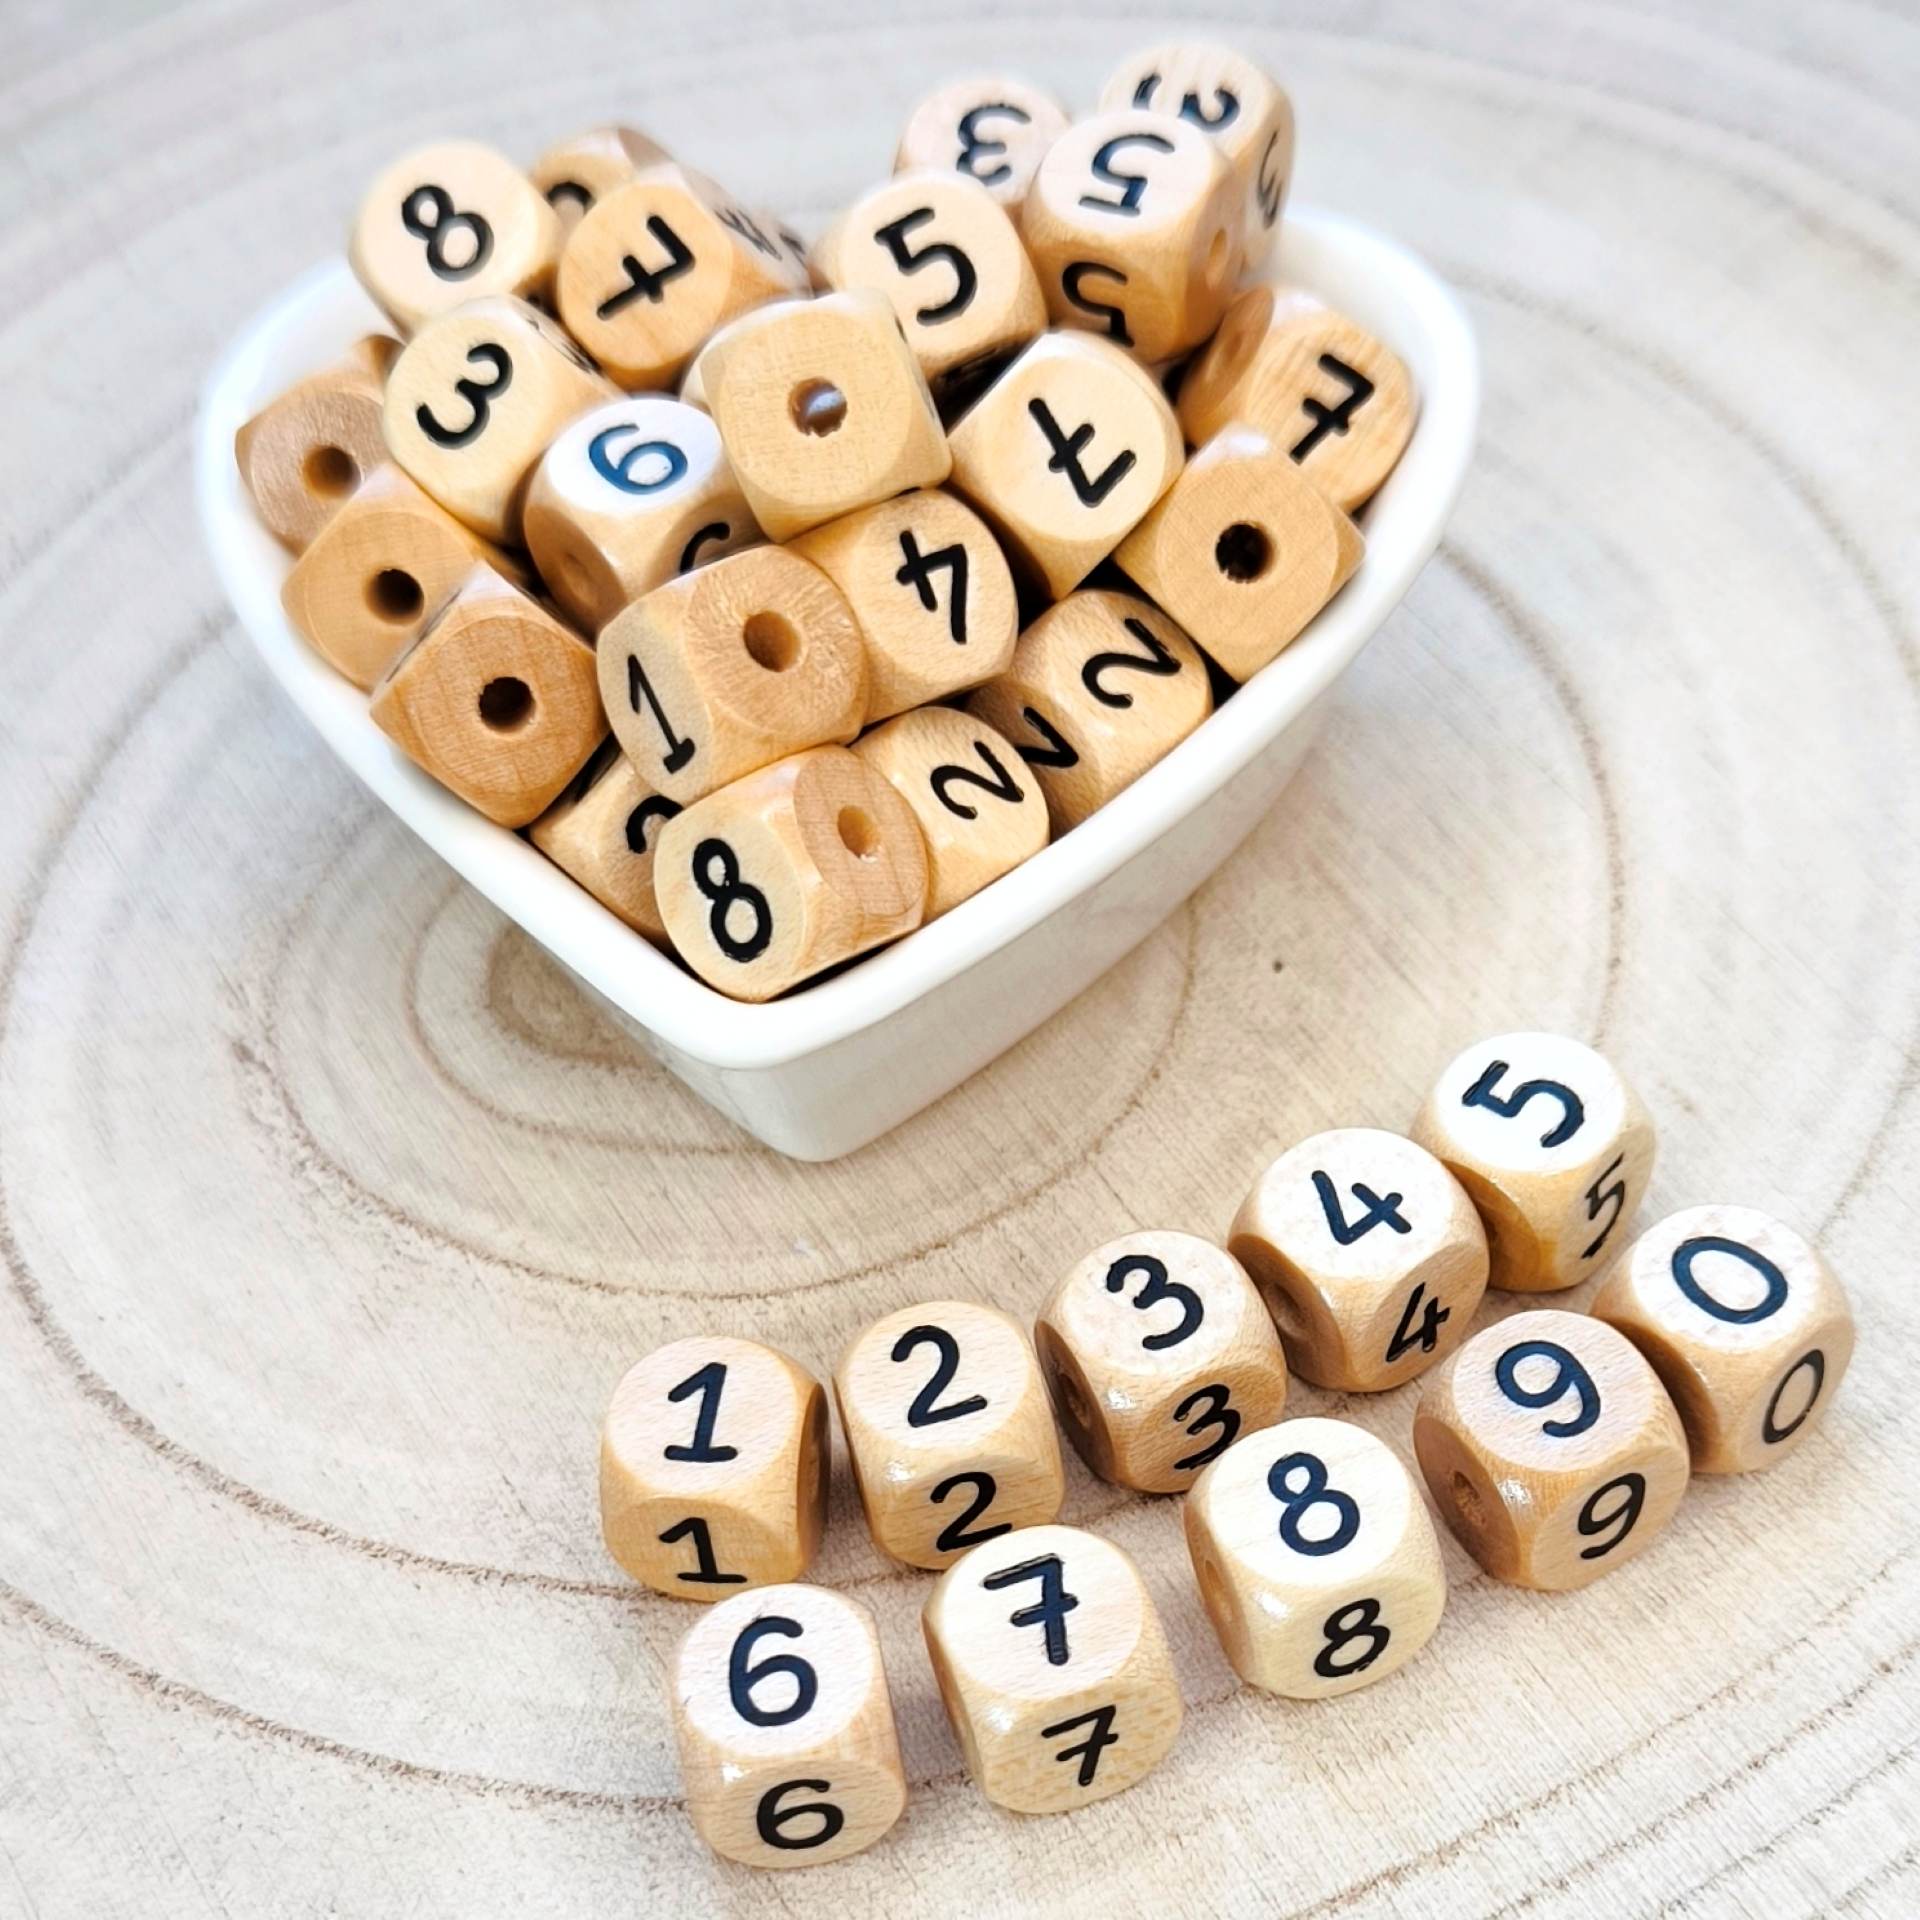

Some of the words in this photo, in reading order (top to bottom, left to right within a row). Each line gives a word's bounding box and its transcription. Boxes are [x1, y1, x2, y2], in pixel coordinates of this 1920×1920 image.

[956, 102, 1030, 186] 3
[1078, 132, 1175, 215] 5
[401, 184, 494, 279] 8
[596, 214, 696, 320] 7
[874, 206, 978, 326] 5
[1061, 261, 1135, 347] 5
[415, 342, 513, 449] 3
[1289, 352, 1376, 465] 7
[1027, 397, 1137, 508] 7
[895, 528, 969, 645] 4
[1081, 617, 1181, 709] 2
[626, 653, 696, 775] 1
[930, 741, 1024, 820] 2
[691, 837, 774, 964] 8
[1461, 1059, 1585, 1149] 5
[1311, 1169, 1413, 1246] 4
[1580, 1153, 1626, 1260] 5
[1105, 1254, 1205, 1352] 3
[1385, 1281, 1451, 1363] 4
[1670, 1235, 1789, 1325] 0
[663, 1361, 739, 1464] 1
[890, 1324, 988, 1429] 2
[1494, 1339, 1601, 1439] 9
[1761, 1348, 1826, 1445] 0
[1172, 1383, 1242, 1471] 3
[657, 1516, 748, 1584] 1
[929, 1471, 1013, 1553] 2
[1266, 1451, 1361, 1557] 8
[1577, 1472, 1647, 1561] 9
[982, 1552, 1080, 1667] 7
[1313, 1597, 1391, 1678] 8
[728, 1615, 819, 1728] 6
[1040, 1704, 1120, 1788] 7
[755, 1778, 845, 1851] 6
